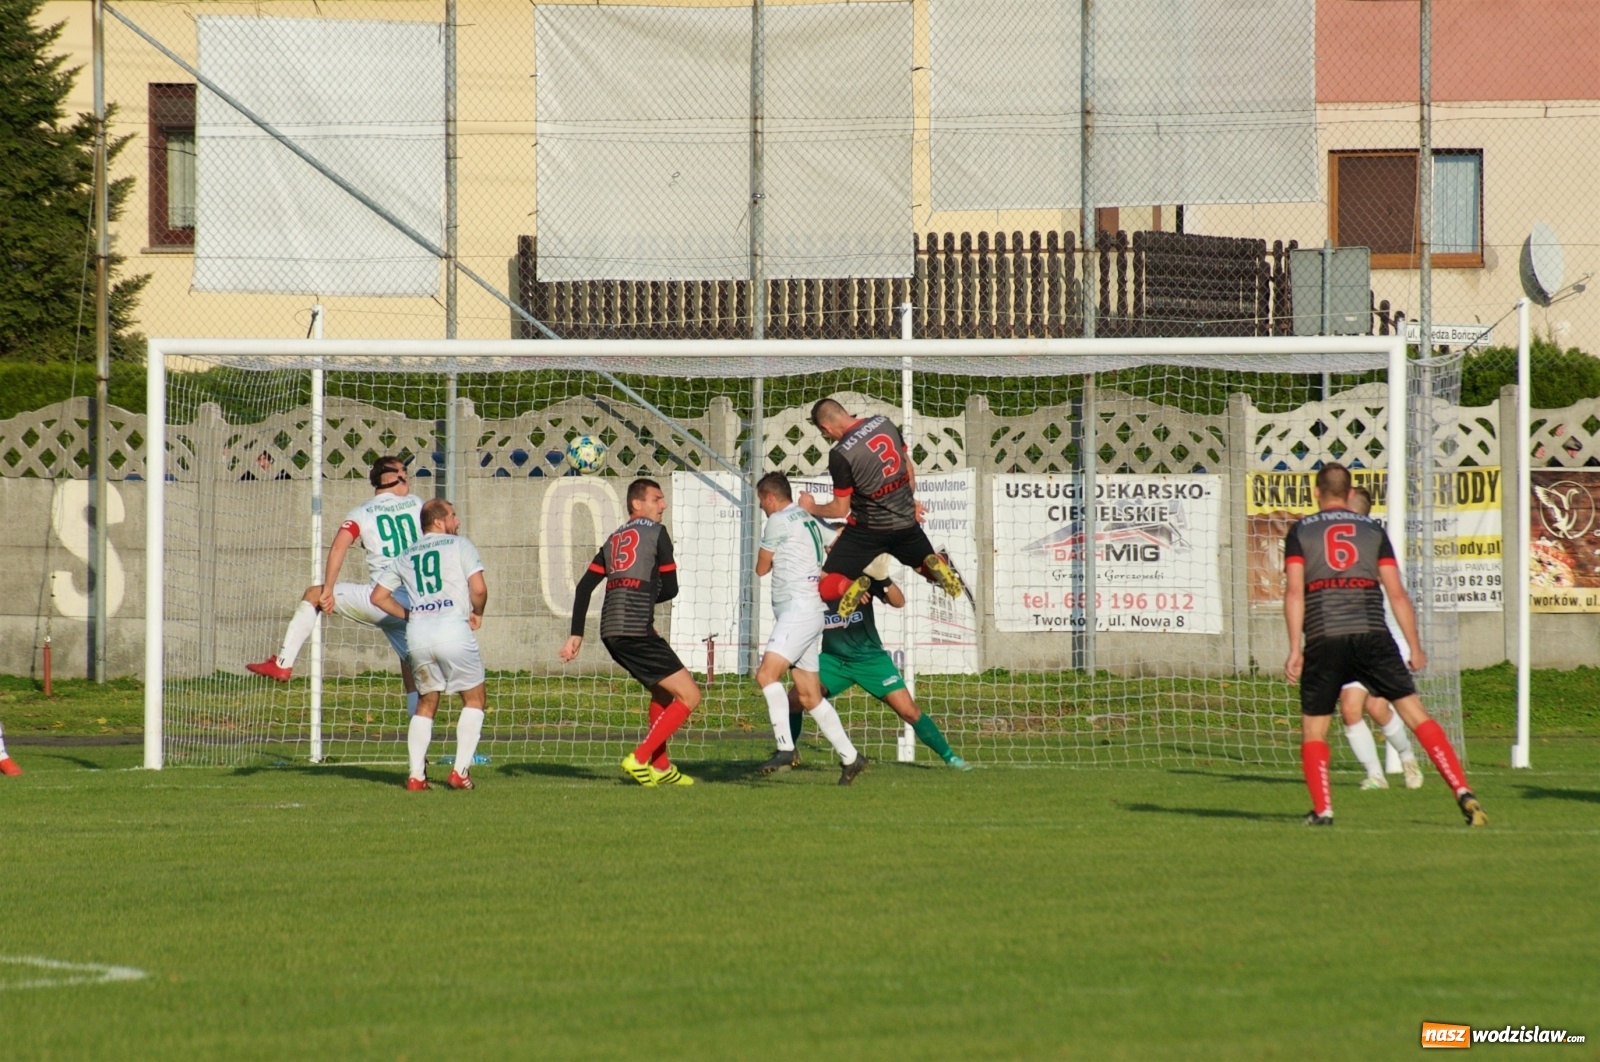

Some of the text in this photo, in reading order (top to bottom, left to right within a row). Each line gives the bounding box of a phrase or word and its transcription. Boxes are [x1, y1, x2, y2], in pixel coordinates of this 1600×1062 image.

[842, 435, 858, 451] LKS
[865, 433, 901, 478] 3
[914, 478, 966, 493] udowlane
[1253, 474, 1313, 507] OKNA
[376, 513, 418, 558] 90
[1323, 522, 1359, 572] 6
[51, 479, 126, 622] S
[609, 528, 640, 574] 13
[410, 550, 443, 598] 19
[1465, 562, 1501, 572] PAWLIK
[1469, 575, 1483, 586] 62
[1487, 574, 1502, 586] 99
[1023, 592, 1056, 609] tel.
[1111, 593, 1148, 610] 196
[1155, 593, 1194, 610] 012
[1490, 591, 1502, 602] 41
[1108, 616, 1126, 627] ul.
[1131, 616, 1171, 627] Nowa
[1176, 616, 1185, 627] 8
